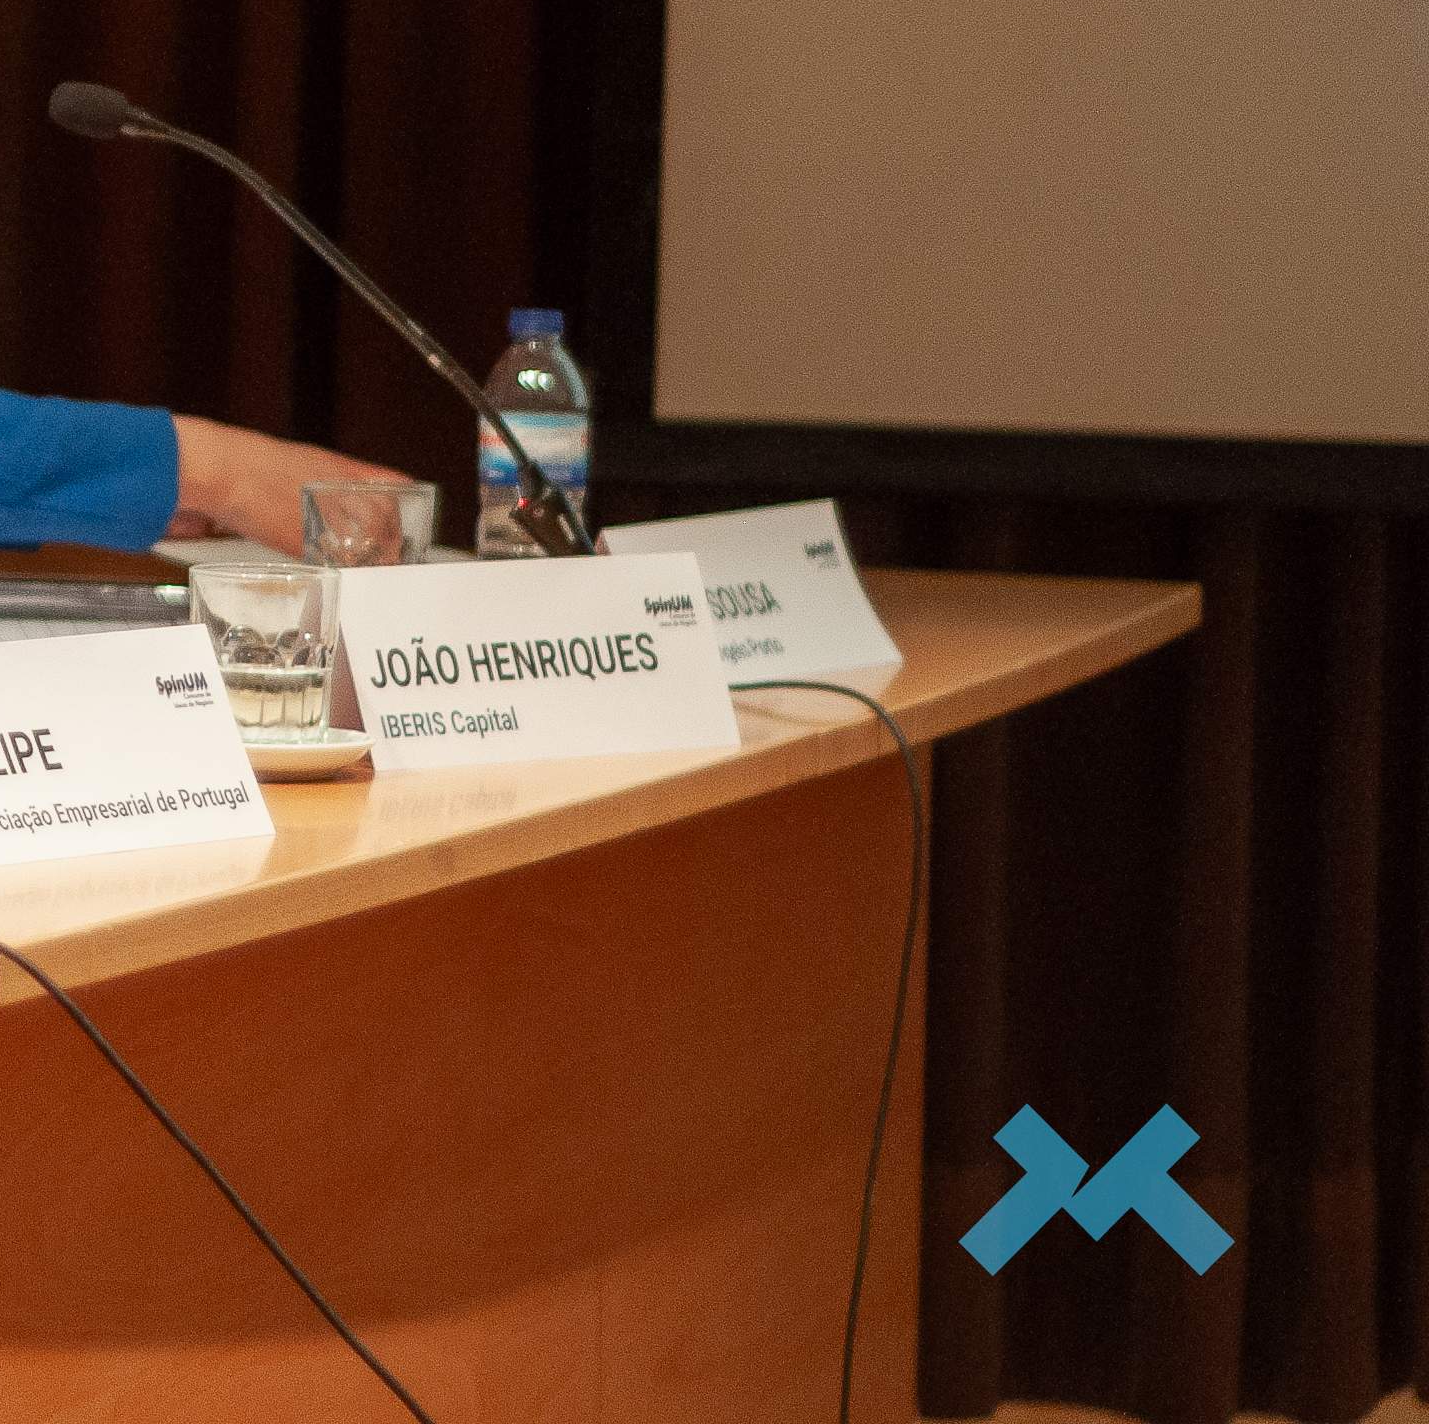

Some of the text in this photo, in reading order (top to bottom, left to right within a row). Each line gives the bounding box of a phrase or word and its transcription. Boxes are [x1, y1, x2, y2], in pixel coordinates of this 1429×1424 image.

[370, 631, 659, 690] JOÃO HENRIQUES
[155, 672, 208, 699] SpinUM
[380, 706, 519, 740] IBERIS Capital
[54, 789, 154, 831] Empresarial
[156, 788, 178, 814] de
[180, 780, 251, 818] Portugal
